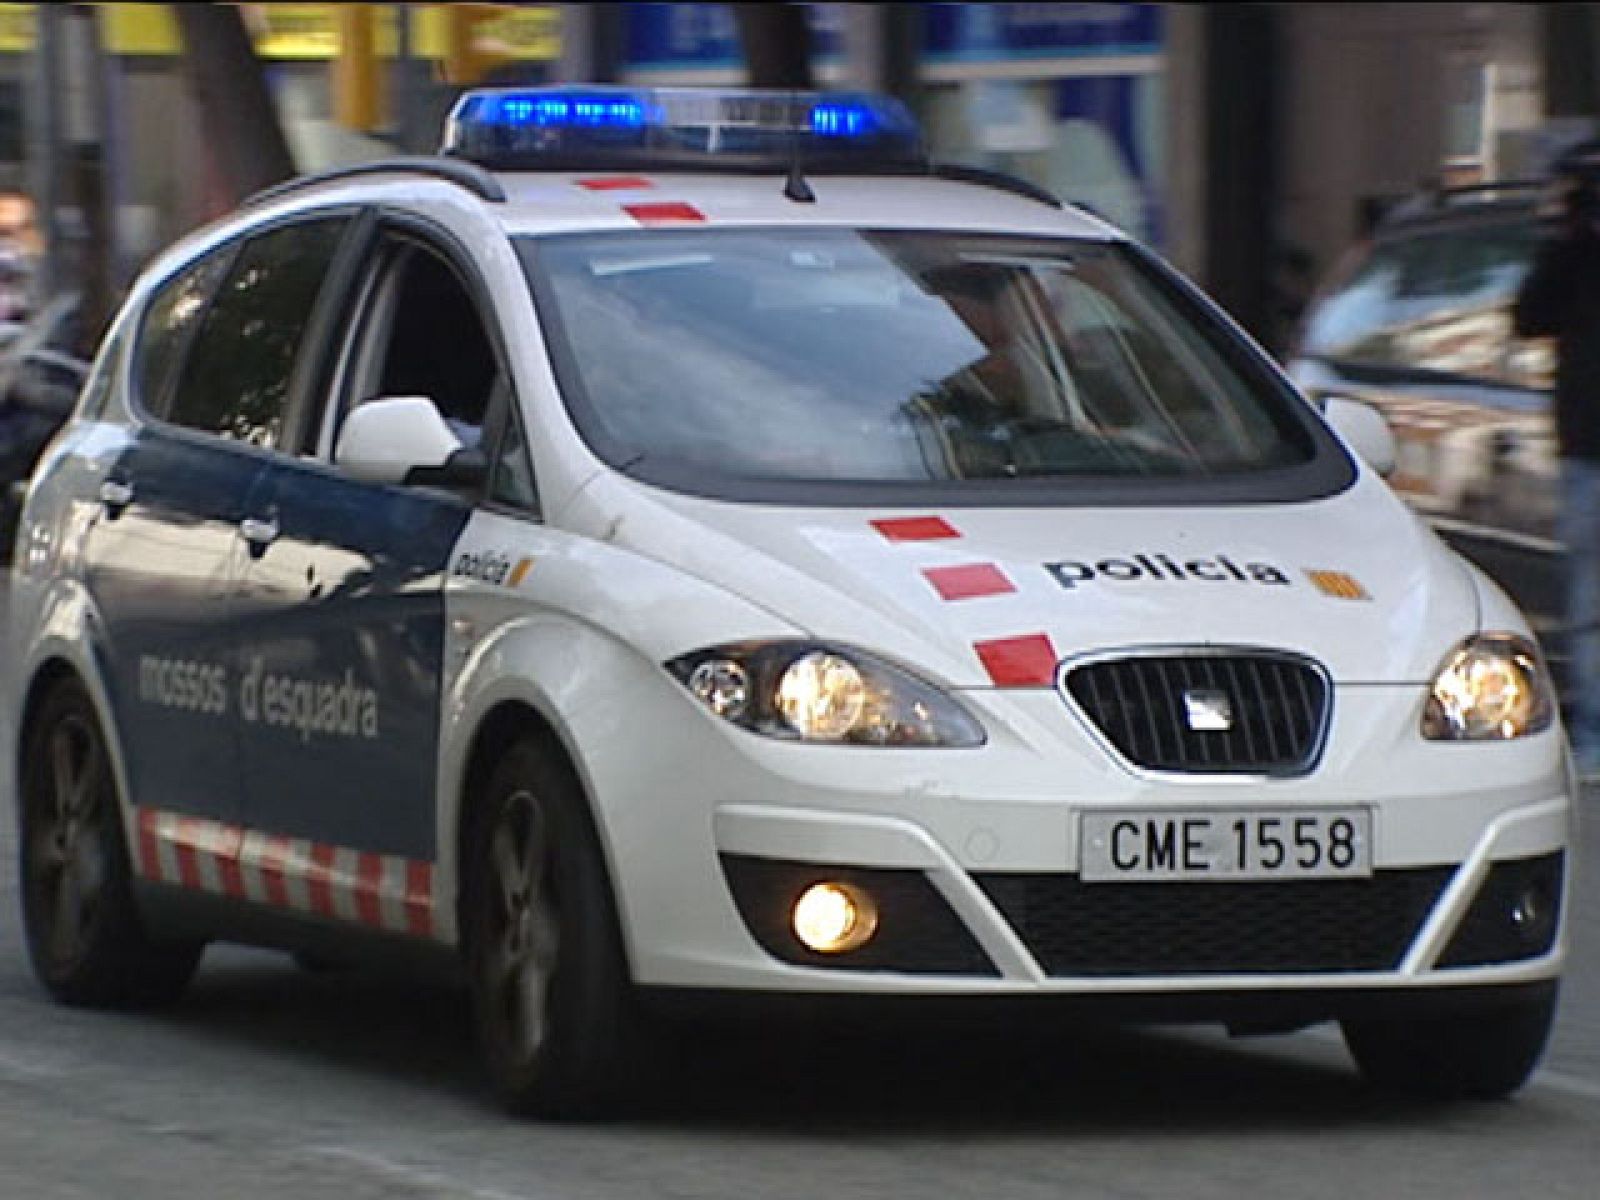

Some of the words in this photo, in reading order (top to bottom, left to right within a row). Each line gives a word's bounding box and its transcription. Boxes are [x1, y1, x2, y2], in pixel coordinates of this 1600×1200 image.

[1043, 553, 1292, 589] policia
[138, 654, 226, 715] mossos
[1110, 819, 1211, 872] CME
[1232, 818, 1356, 871] 1558
